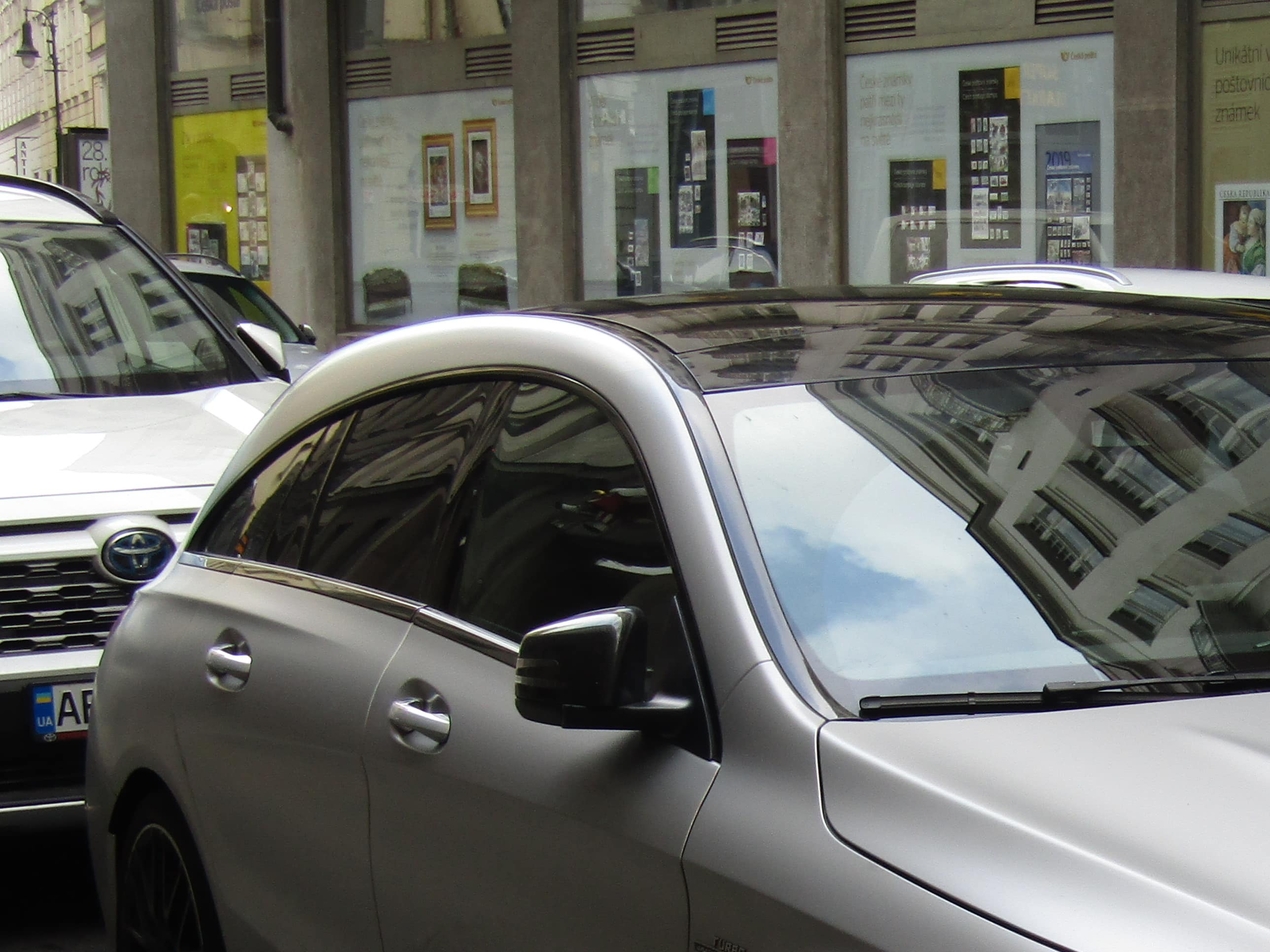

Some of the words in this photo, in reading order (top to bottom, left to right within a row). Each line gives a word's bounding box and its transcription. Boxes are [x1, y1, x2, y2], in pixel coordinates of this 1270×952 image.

[1215, 43, 1262, 66] Unikátní
[1215, 103, 1261, 123] známek
[82, 141, 107, 161] 28.
[1046, 151, 1071, 169] 2019
[37, 716, 54, 728] UA
